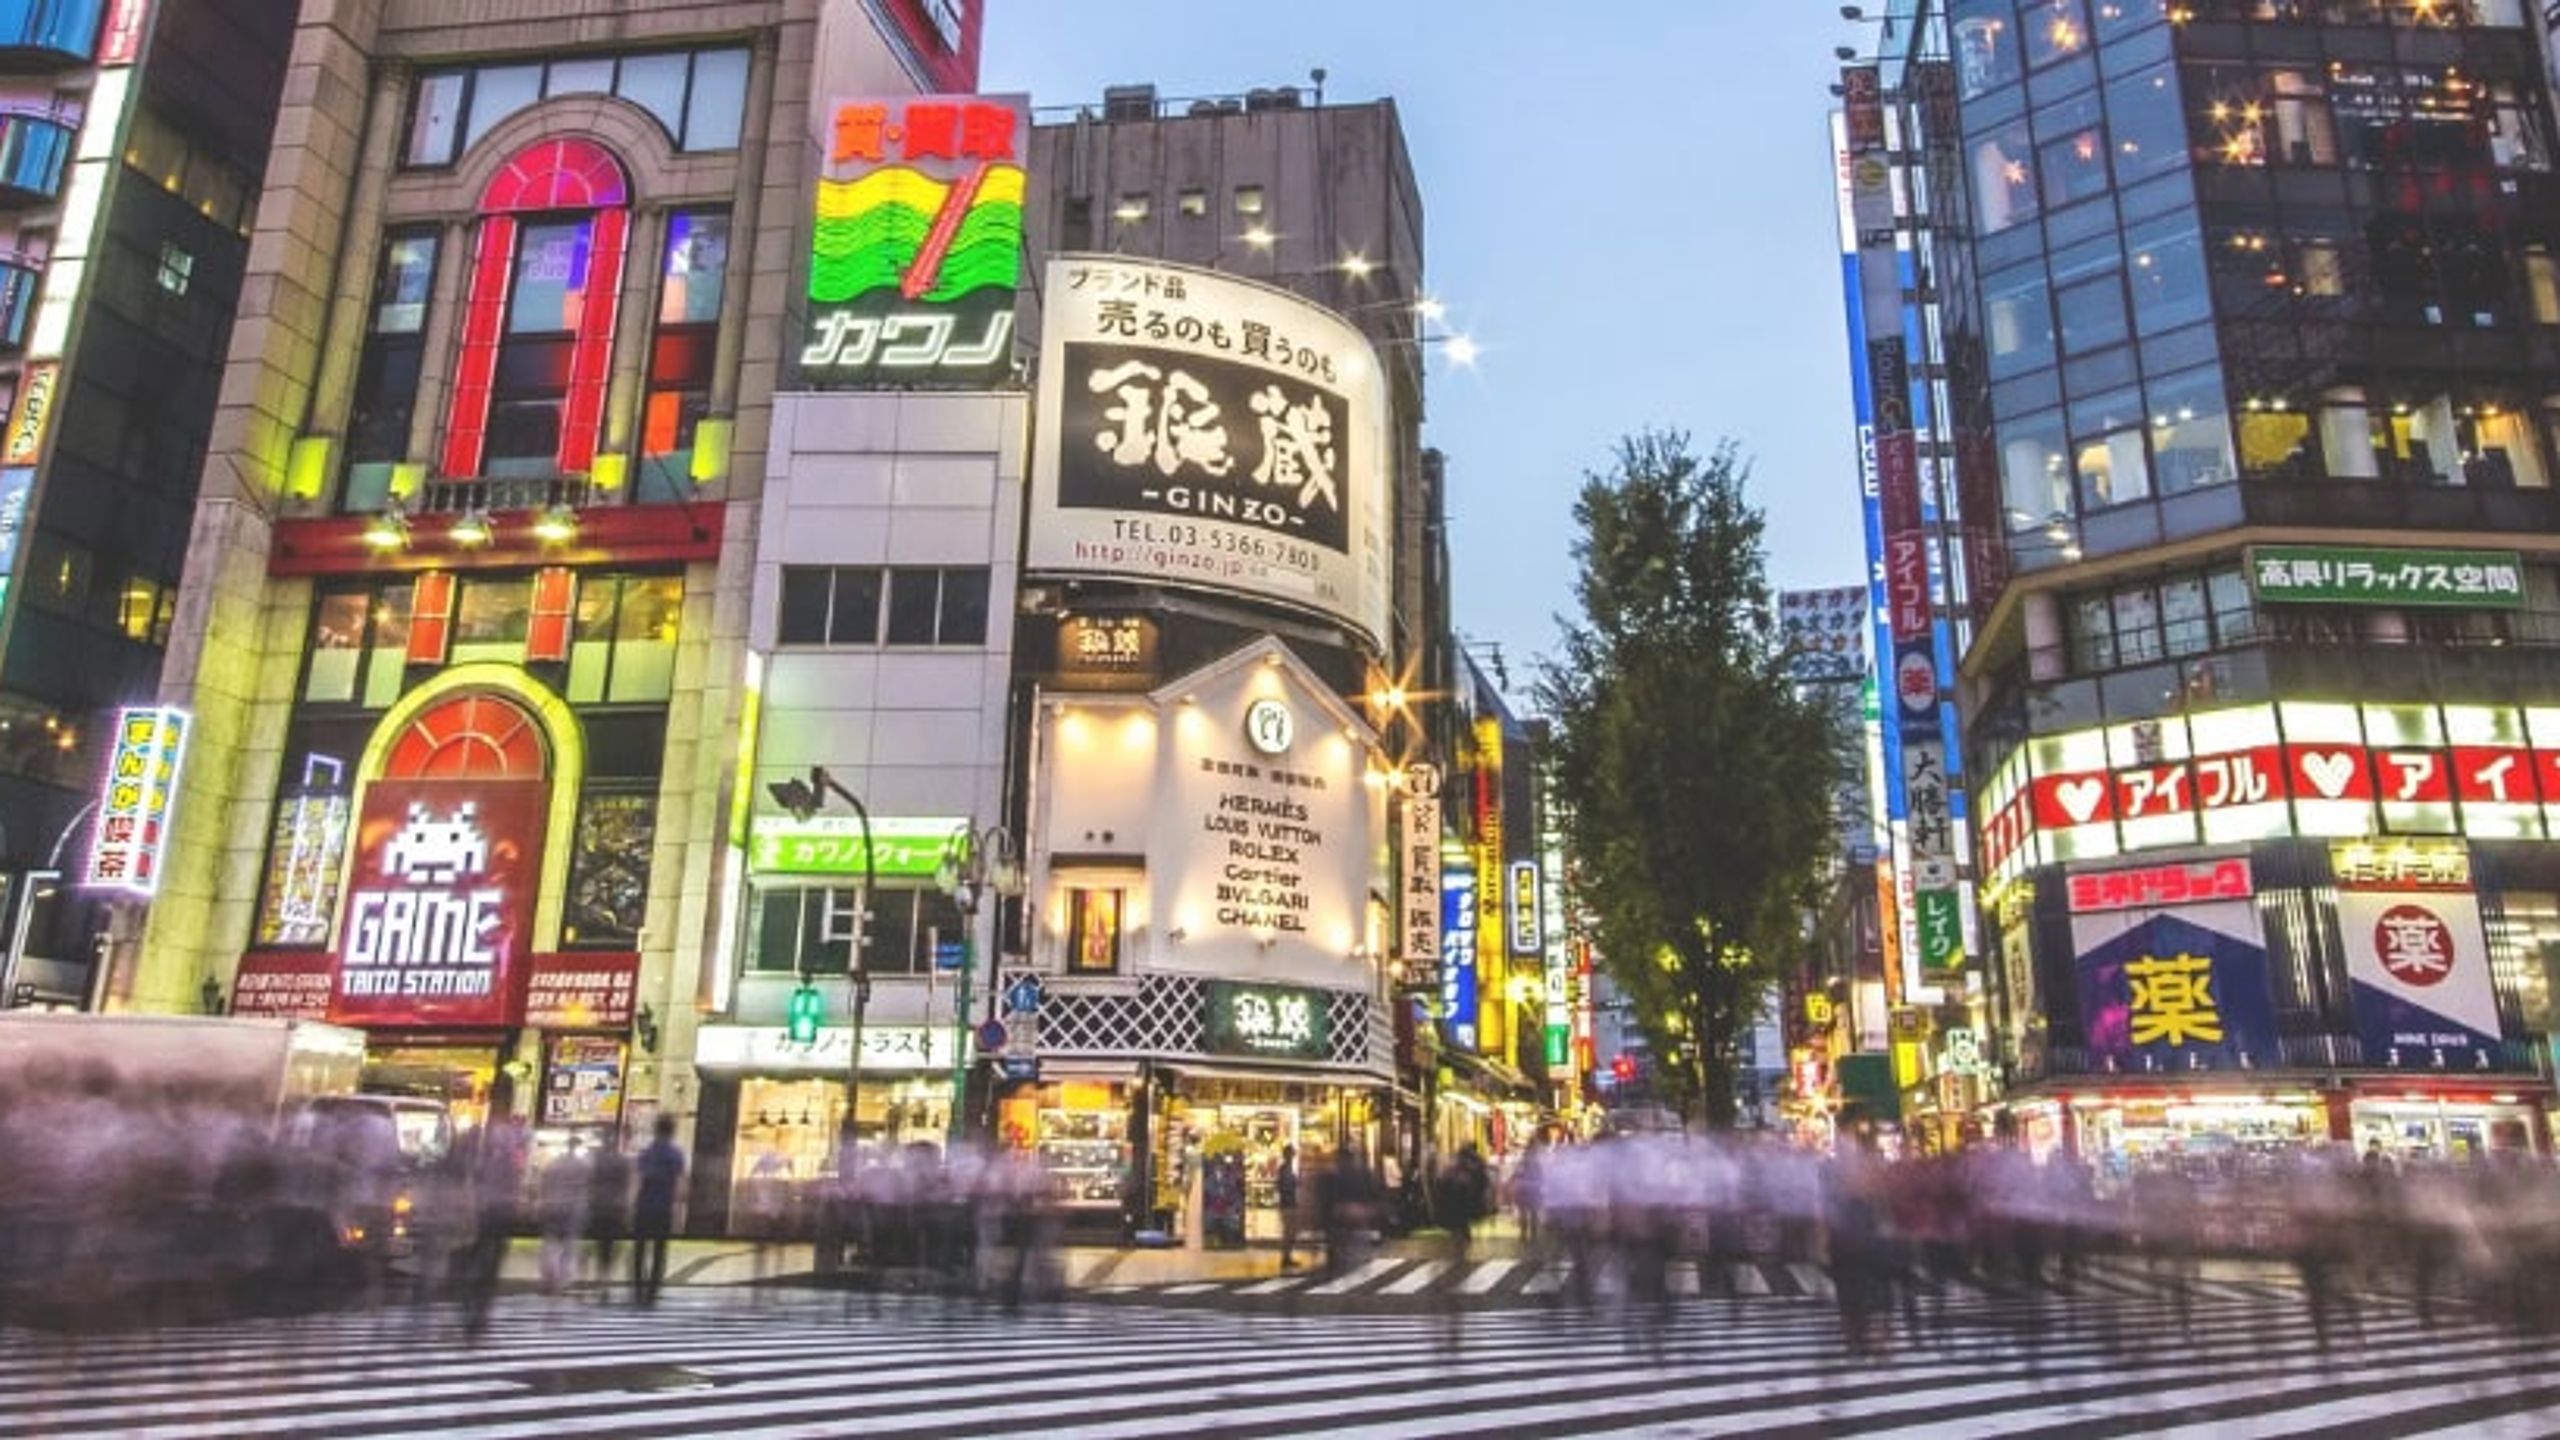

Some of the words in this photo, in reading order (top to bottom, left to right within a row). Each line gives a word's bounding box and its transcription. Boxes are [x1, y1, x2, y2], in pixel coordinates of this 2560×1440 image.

[1068, 268, 1187, 300] ブランド品
[800, 311, 1015, 366] カワノ
[1097, 297, 1232, 350] 売るのも
[1241, 318, 1337, 384] 買うのも
[1893, 540, 1928, 632] アイフル
[1909, 751, 1950, 855] 大勝軒
[2120, 754, 2268, 816] アイフル
[2388, 753, 2560, 803] アイ
[1203, 814, 1250, 838] LOUIS
[1257, 821, 1322, 846] VUITTON
[1228, 838, 1300, 865] ROLEX
[1216, 883, 1310, 910] BVLGARI
[1224, 863, 1302, 888] Cartier
[347, 892, 501, 965] GAME
[1217, 907, 1307, 932] CHANEL
[1926, 895, 1952, 956] レイク
[2382, 915, 2450, 972] 薬
[342, 970, 398, 995] TAITO
[402, 970, 490, 995] STATION
[2123, 951, 2224, 1047] 薬
